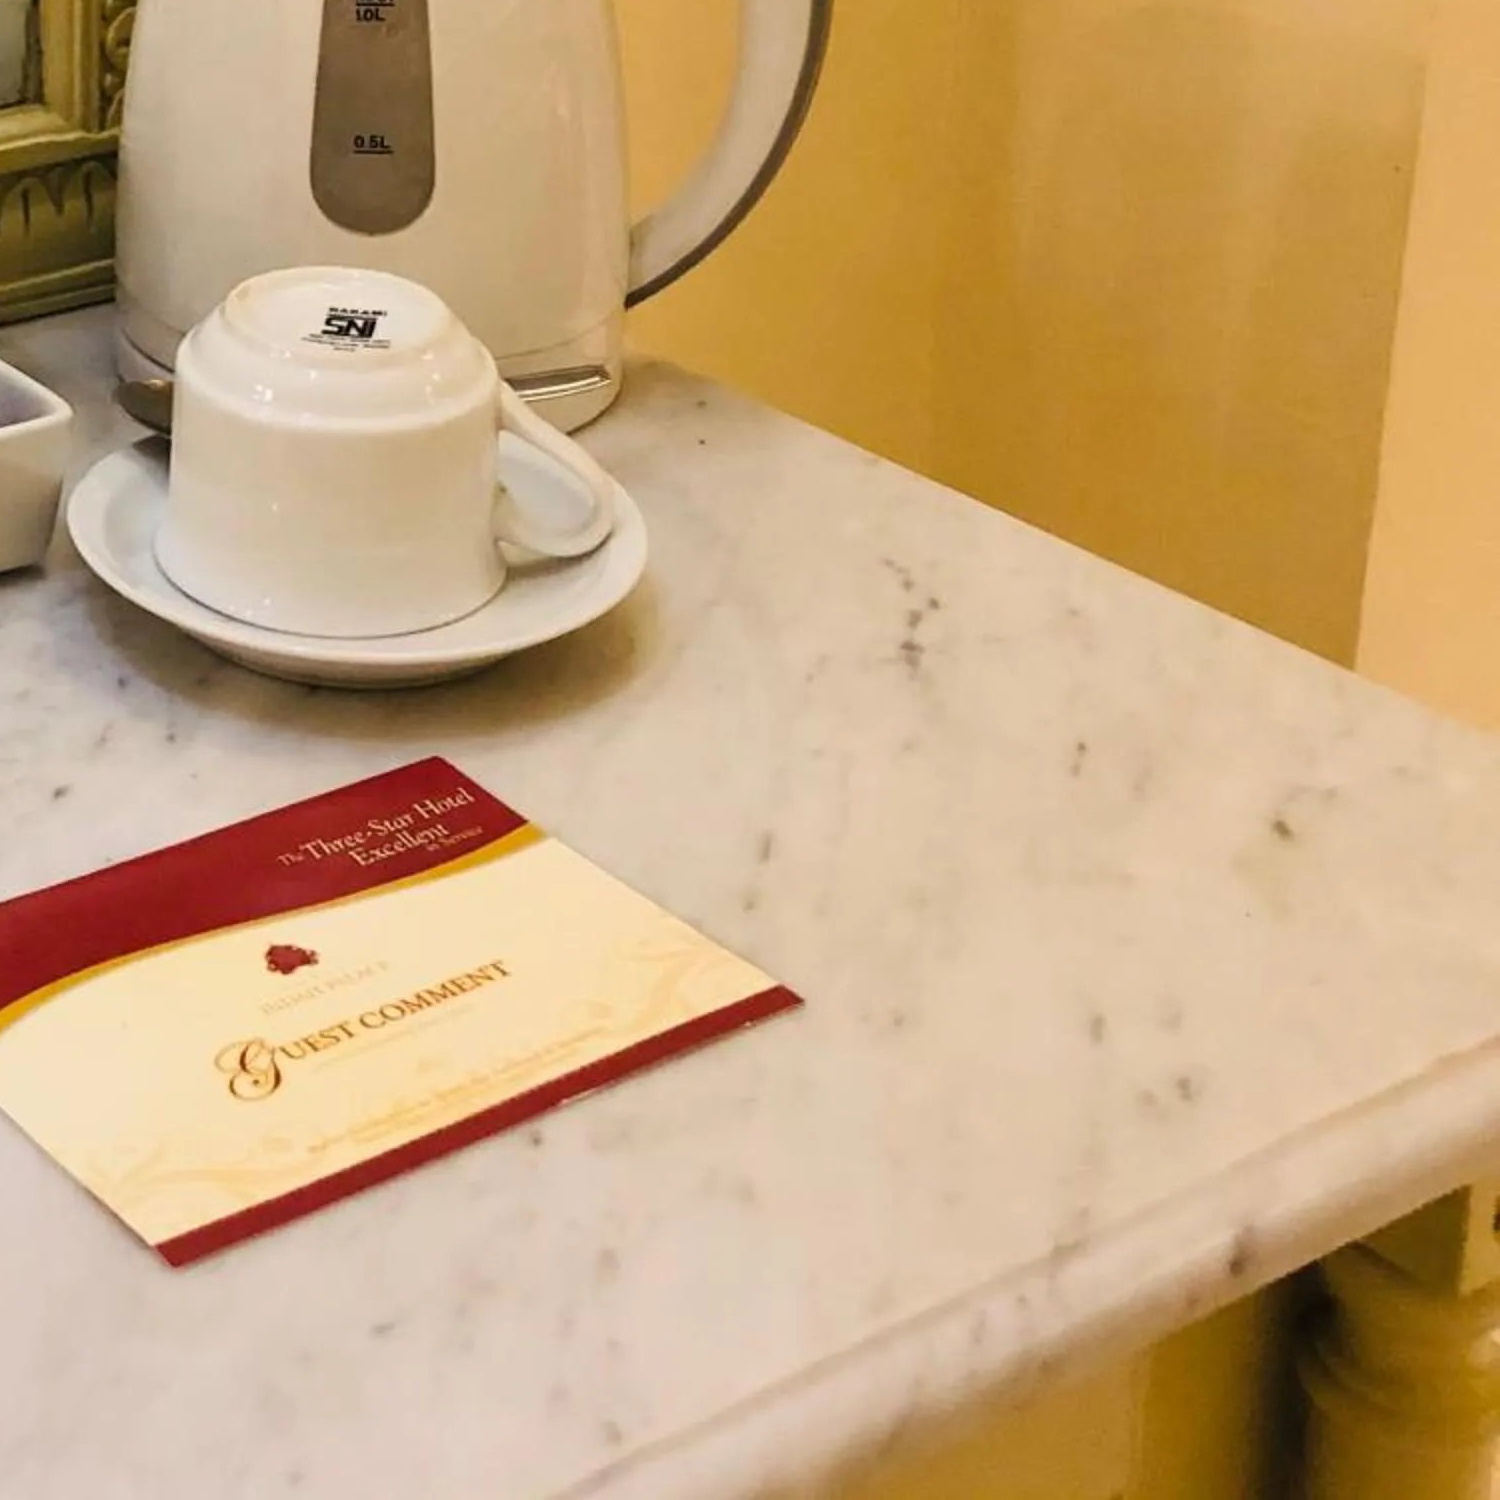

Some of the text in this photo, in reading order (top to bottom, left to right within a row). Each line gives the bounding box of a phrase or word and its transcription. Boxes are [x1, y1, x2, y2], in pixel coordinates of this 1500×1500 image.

[321, 315, 377, 338] SNI
[298, 813, 415, 860] Three-Star
[412, 787, 476, 819] Hotel
[348, 823, 450, 866] Excellent
[213, 1019, 356, 1102] GUEST
[358, 959, 512, 1029] COMMENT
